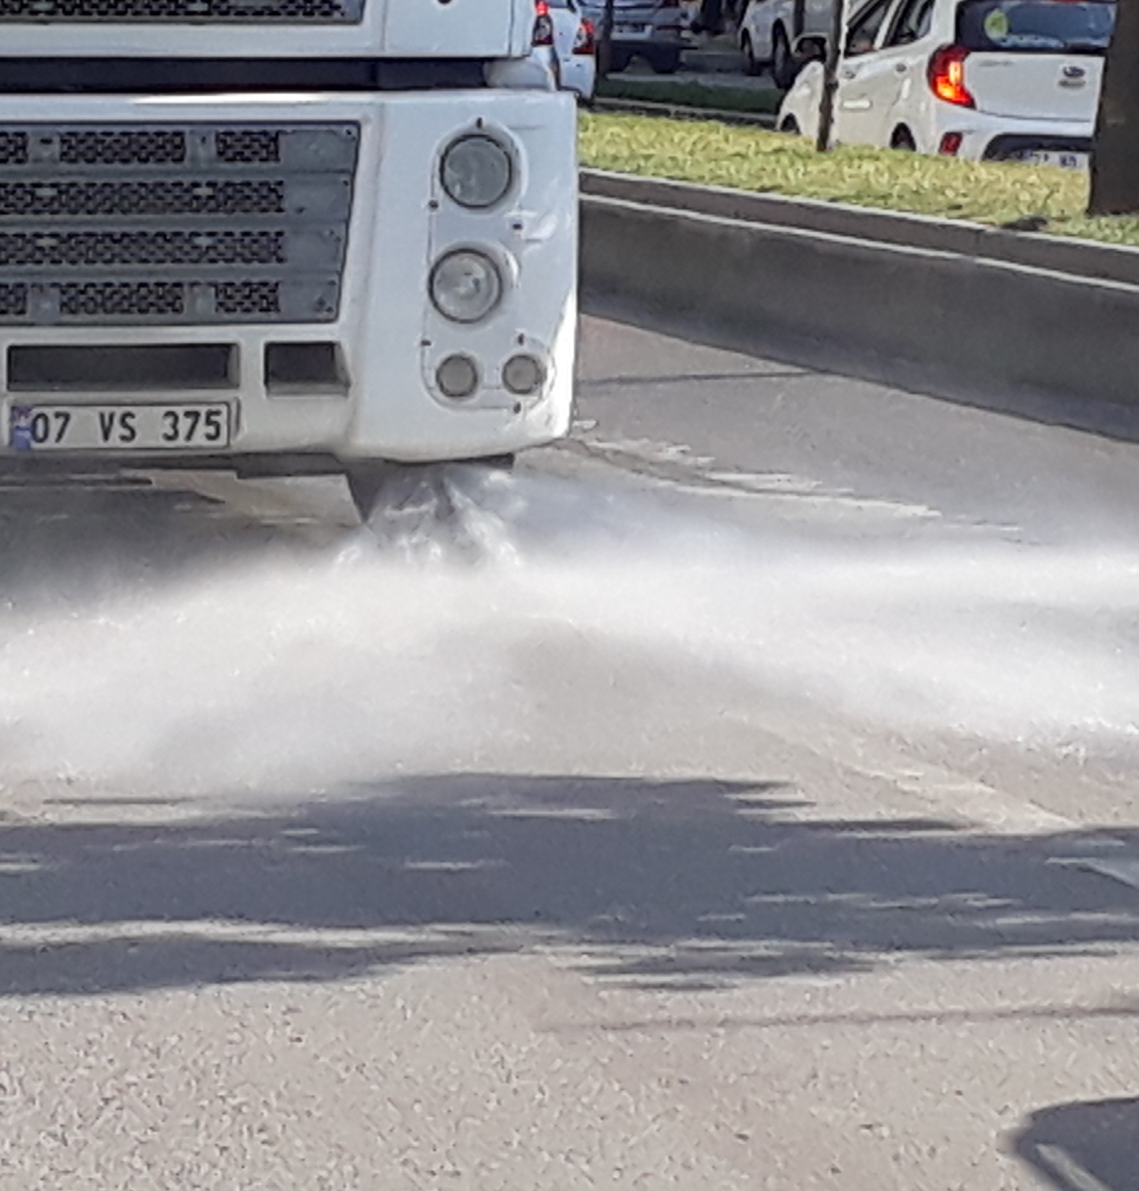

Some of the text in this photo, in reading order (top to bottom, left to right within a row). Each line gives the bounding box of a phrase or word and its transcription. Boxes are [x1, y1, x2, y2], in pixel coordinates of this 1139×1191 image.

[31, 409, 223, 444] 07 VS 375
